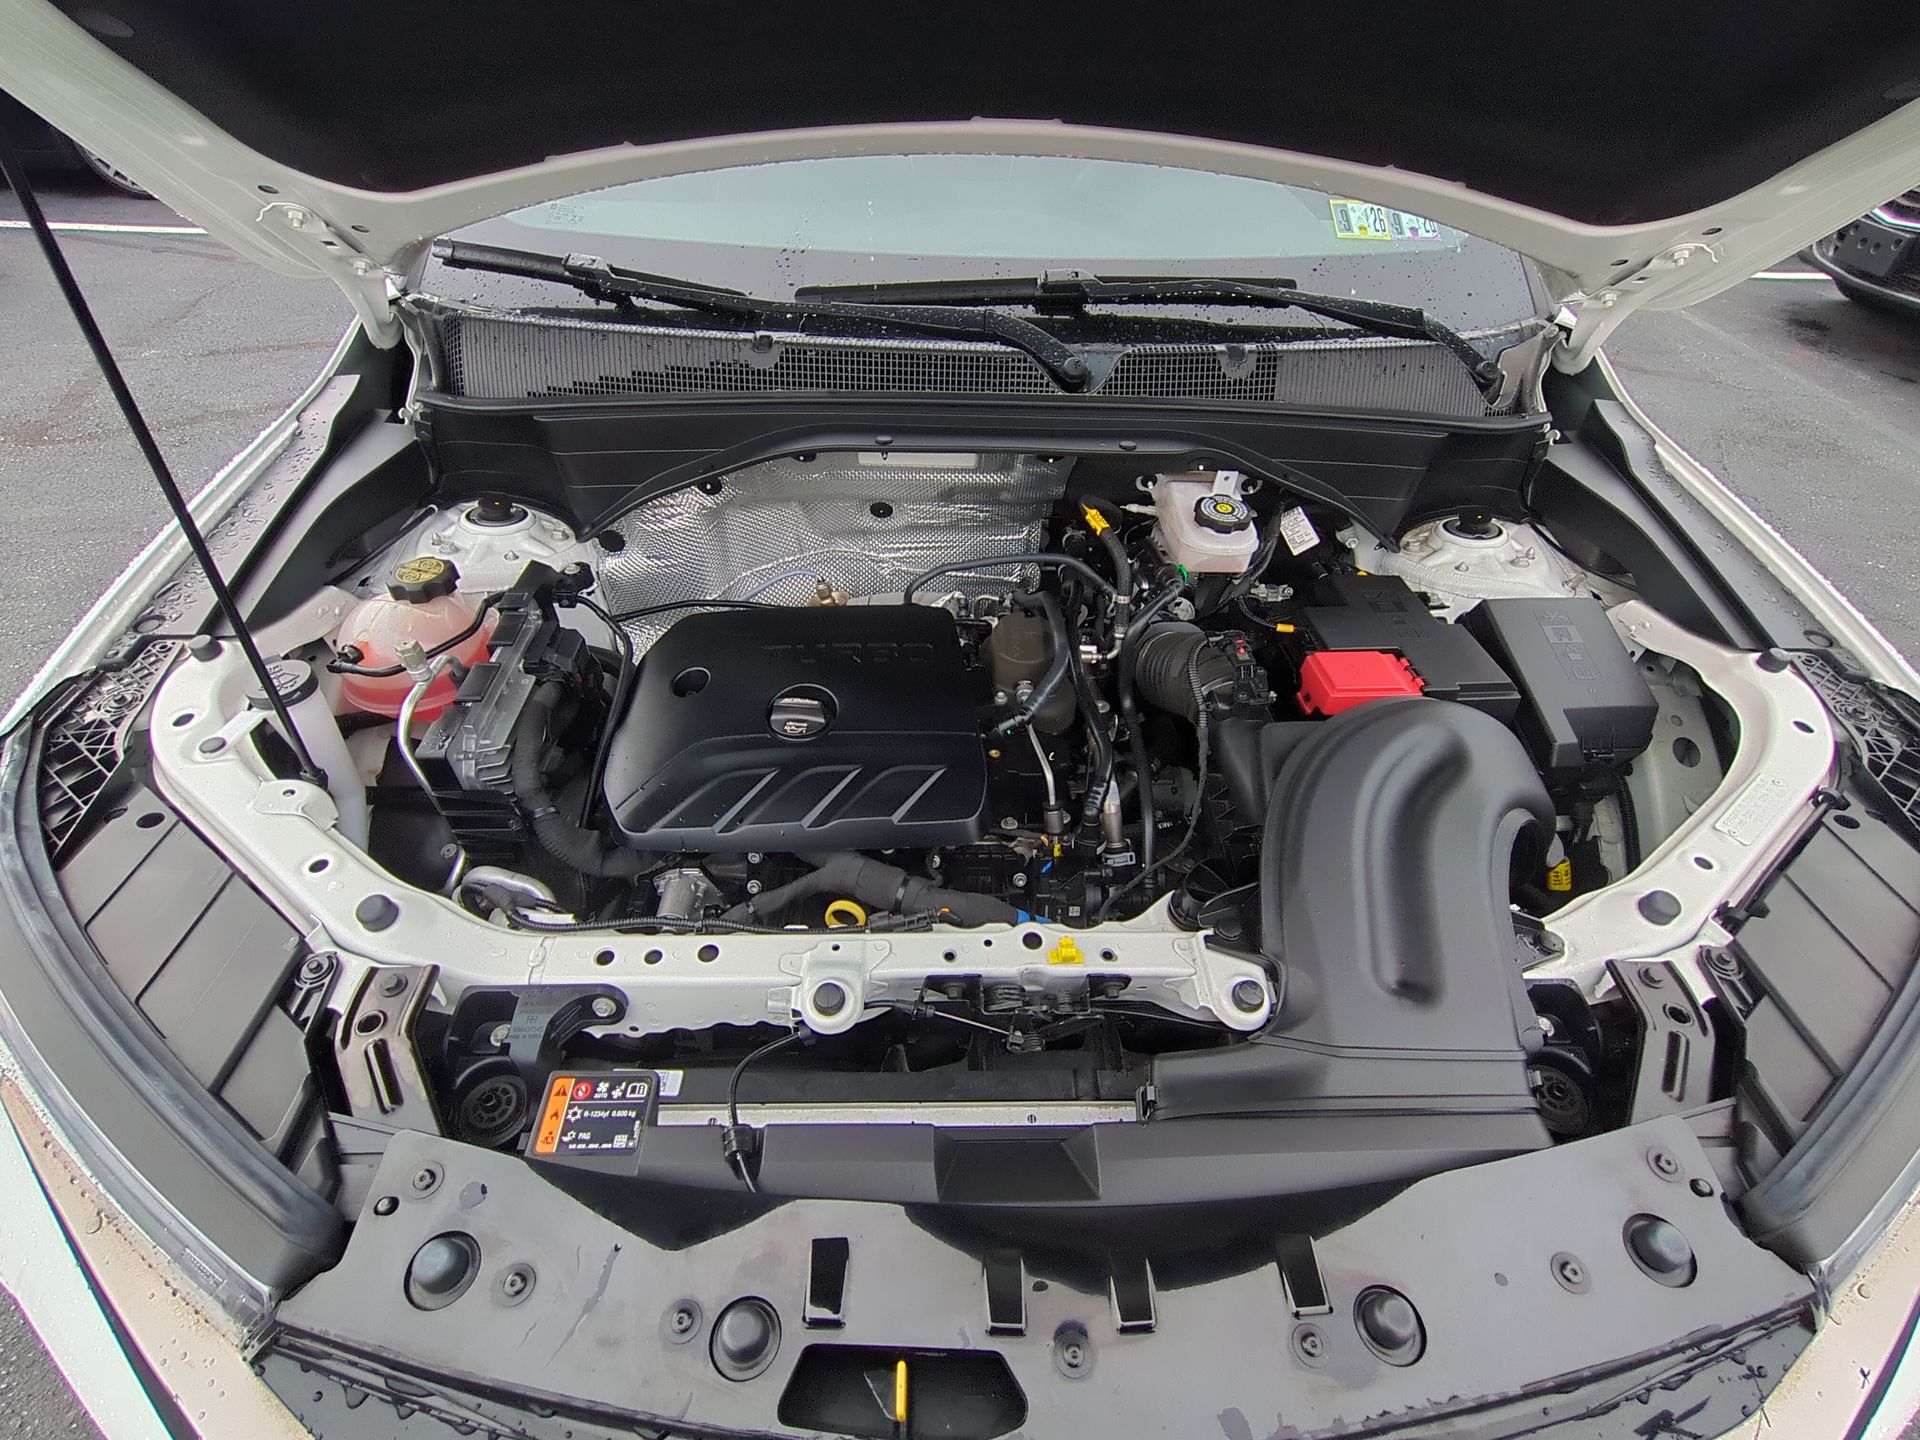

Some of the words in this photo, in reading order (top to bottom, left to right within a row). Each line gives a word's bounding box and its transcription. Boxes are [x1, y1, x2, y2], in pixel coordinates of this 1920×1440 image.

[1339, 208, 1351, 232] 9
[1369, 206, 1386, 232] 26
[1392, 213, 1403, 235] 9
[761, 643, 935, 668] TURBO
[578, 1132, 591, 1140] PAG
